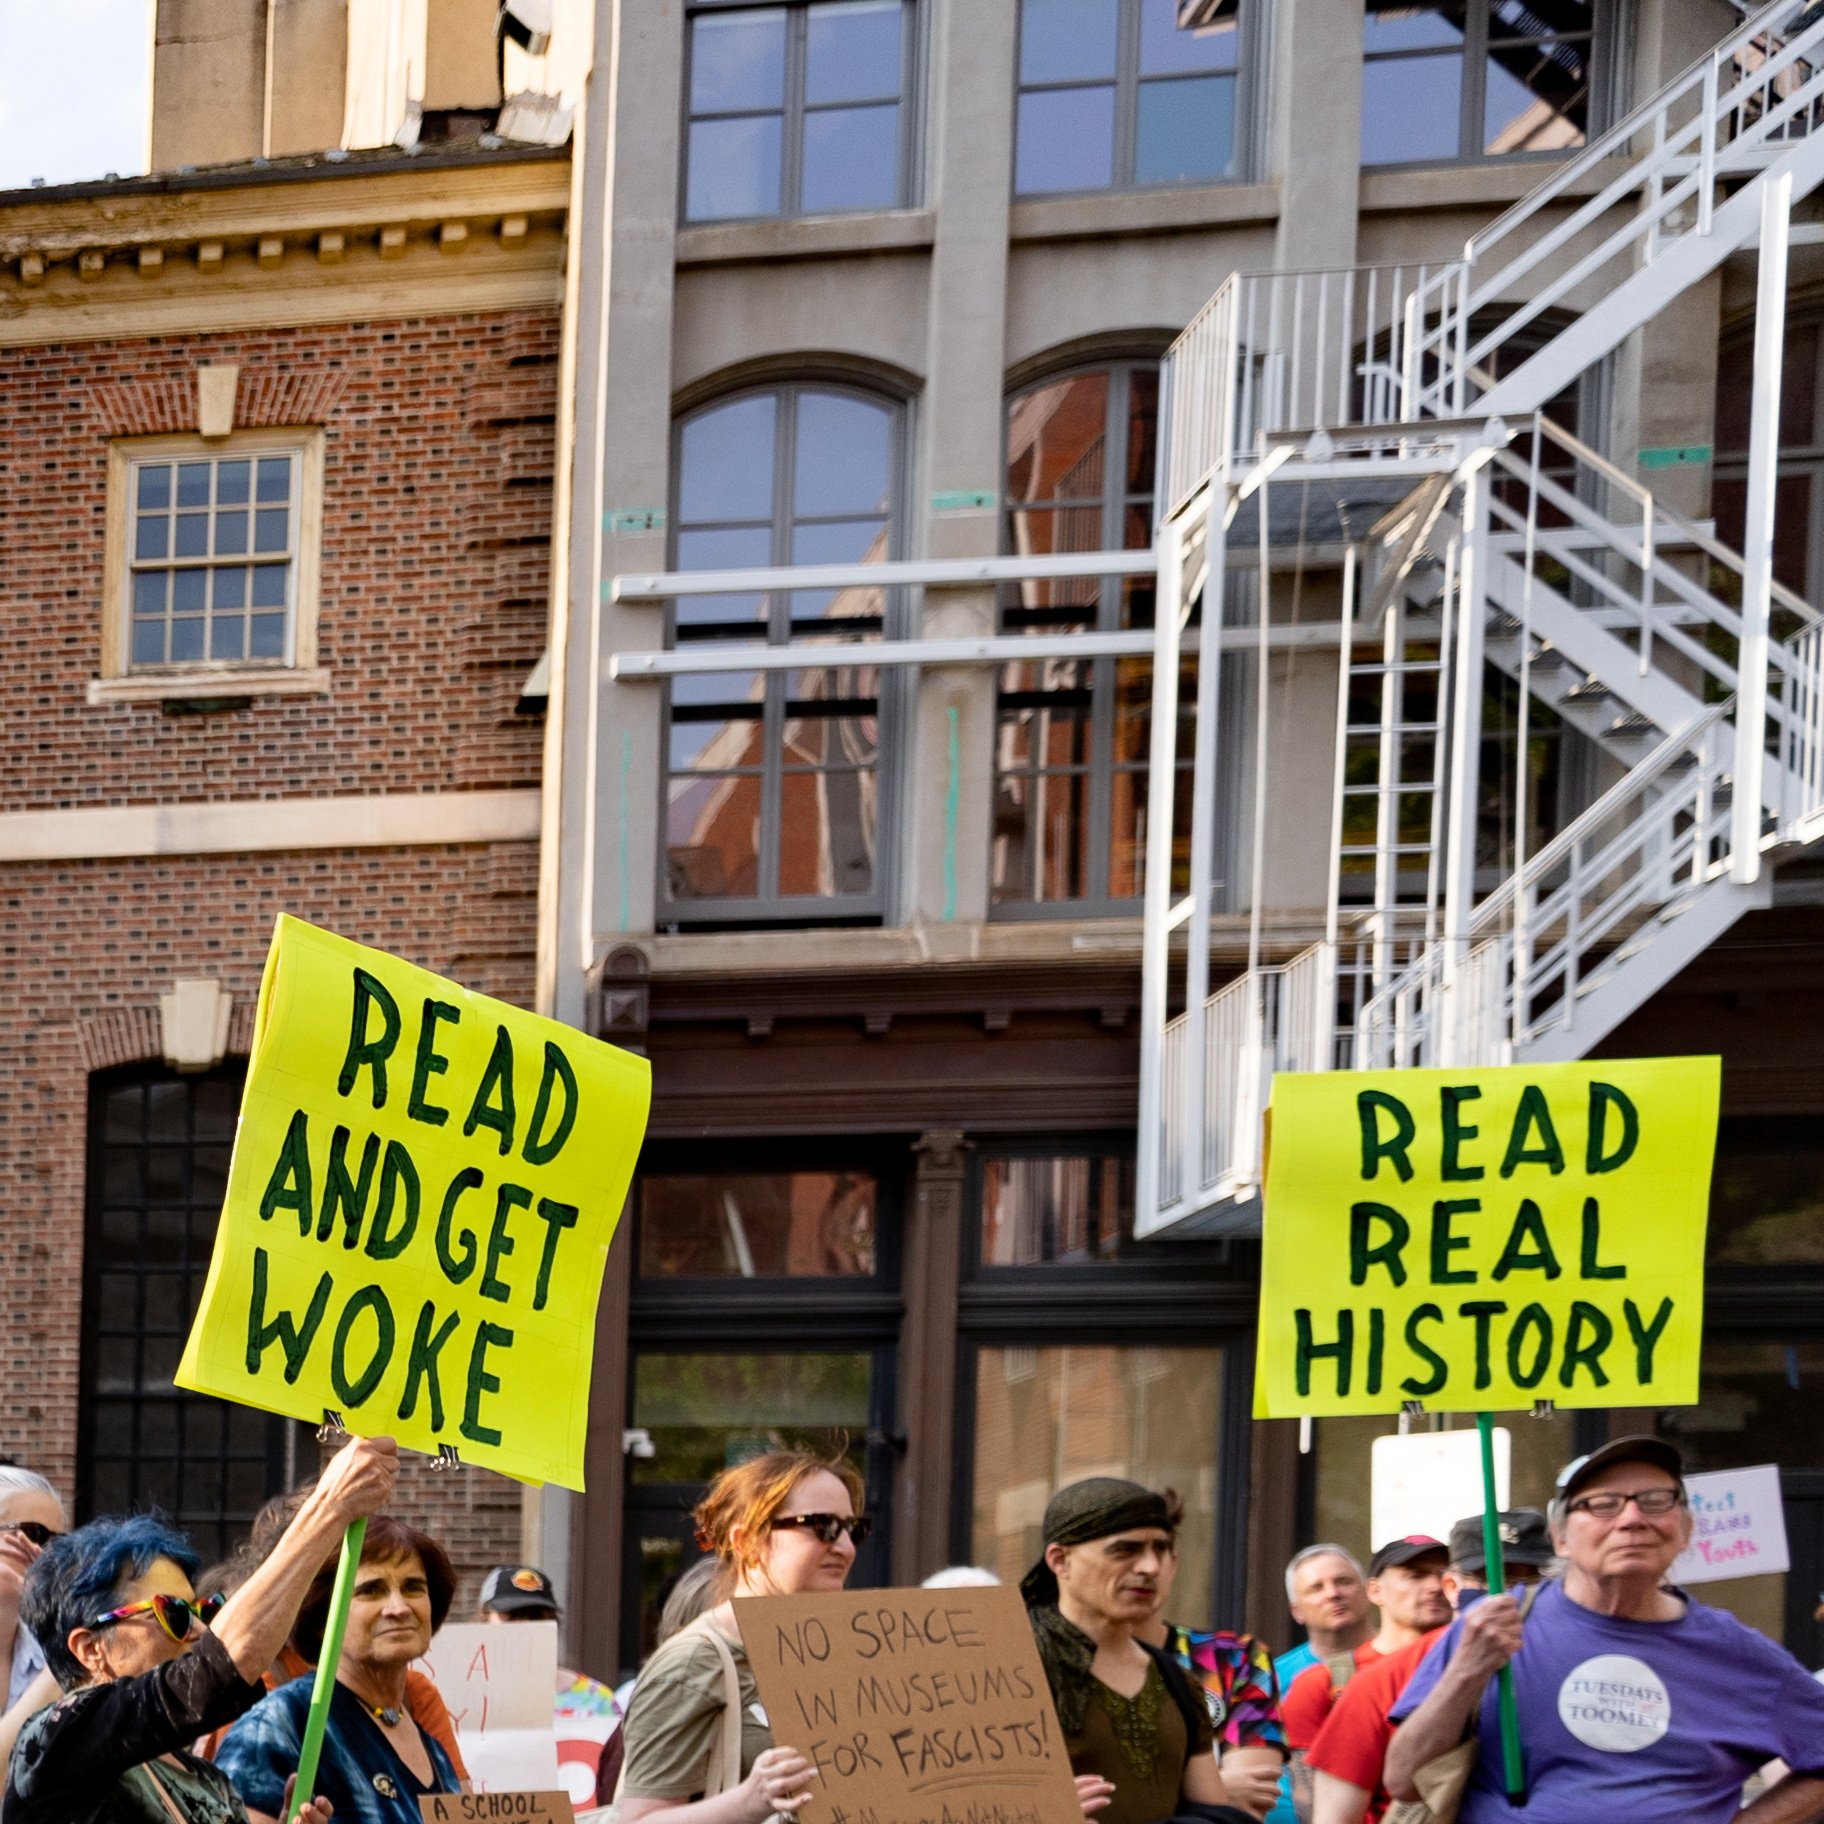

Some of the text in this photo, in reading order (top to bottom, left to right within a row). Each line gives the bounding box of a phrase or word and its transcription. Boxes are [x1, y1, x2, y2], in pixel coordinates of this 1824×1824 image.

[338, 967, 579, 1167] READ
[1356, 1080, 1640, 1184] READ
[259, 1108, 580, 1311] AND GET
[1349, 1196, 1627, 1288] REAL
[244, 1246, 515, 1447] WOKE
[1294, 1295, 1675, 1397] HISTORY
[466, 1644, 490, 1682] A
[776, 1607, 986, 1667] NO SPACE
[793, 1664, 1036, 1731] IN MUSEUMS
[810, 1708, 1053, 1790] FOR FASCISTS!
[433, 1793, 547, 1822] A SCHOOL
